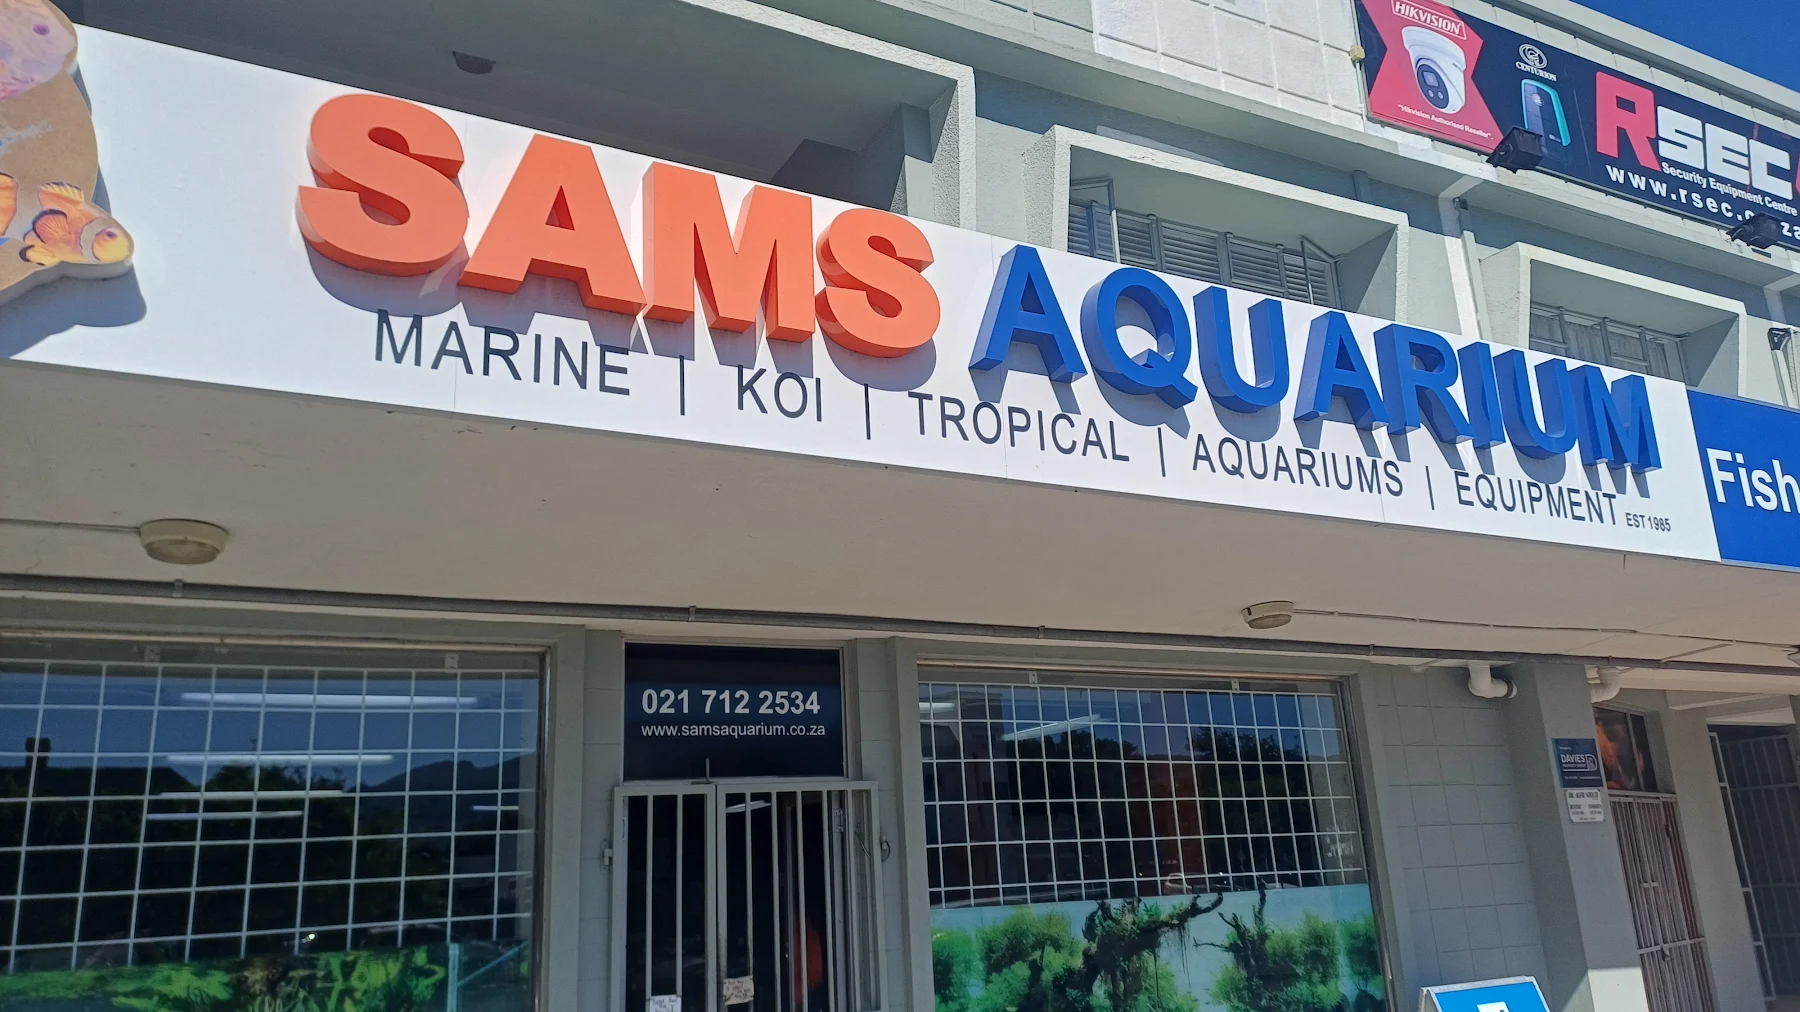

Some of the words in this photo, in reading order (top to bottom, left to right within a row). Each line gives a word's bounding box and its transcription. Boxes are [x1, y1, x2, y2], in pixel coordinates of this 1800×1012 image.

[1395, 1, 1461, 35] HIKVISION
[1515, 61, 1557, 82] CENTURION
[1596, 71, 1793, 200] RSEC
[1661, 161, 1707, 188] Security
[1708, 177, 1764, 206] Equipment
[1764, 196, 1798, 217] Centre
[297, 93, 941, 358] SAMS
[969, 244, 1662, 474] AQUARIUM
[375, 308, 631, 397] MARINE
[736, 364, 823, 423] KOI
[907, 391, 1131, 464] TROPICAL
[1192, 433, 1404, 498] AQUARIUMS
[1454, 470, 1617, 526] EQUIPMENT
[1706, 447, 1800, 515] Fish
[641, 689, 690, 714] 021
[701, 690, 750, 714] 712
[758, 691, 821, 715] 2534
[641, 722, 826, 739] www.samsaquarium.co.za
[1560, 754, 1585, 763] DAVIES
